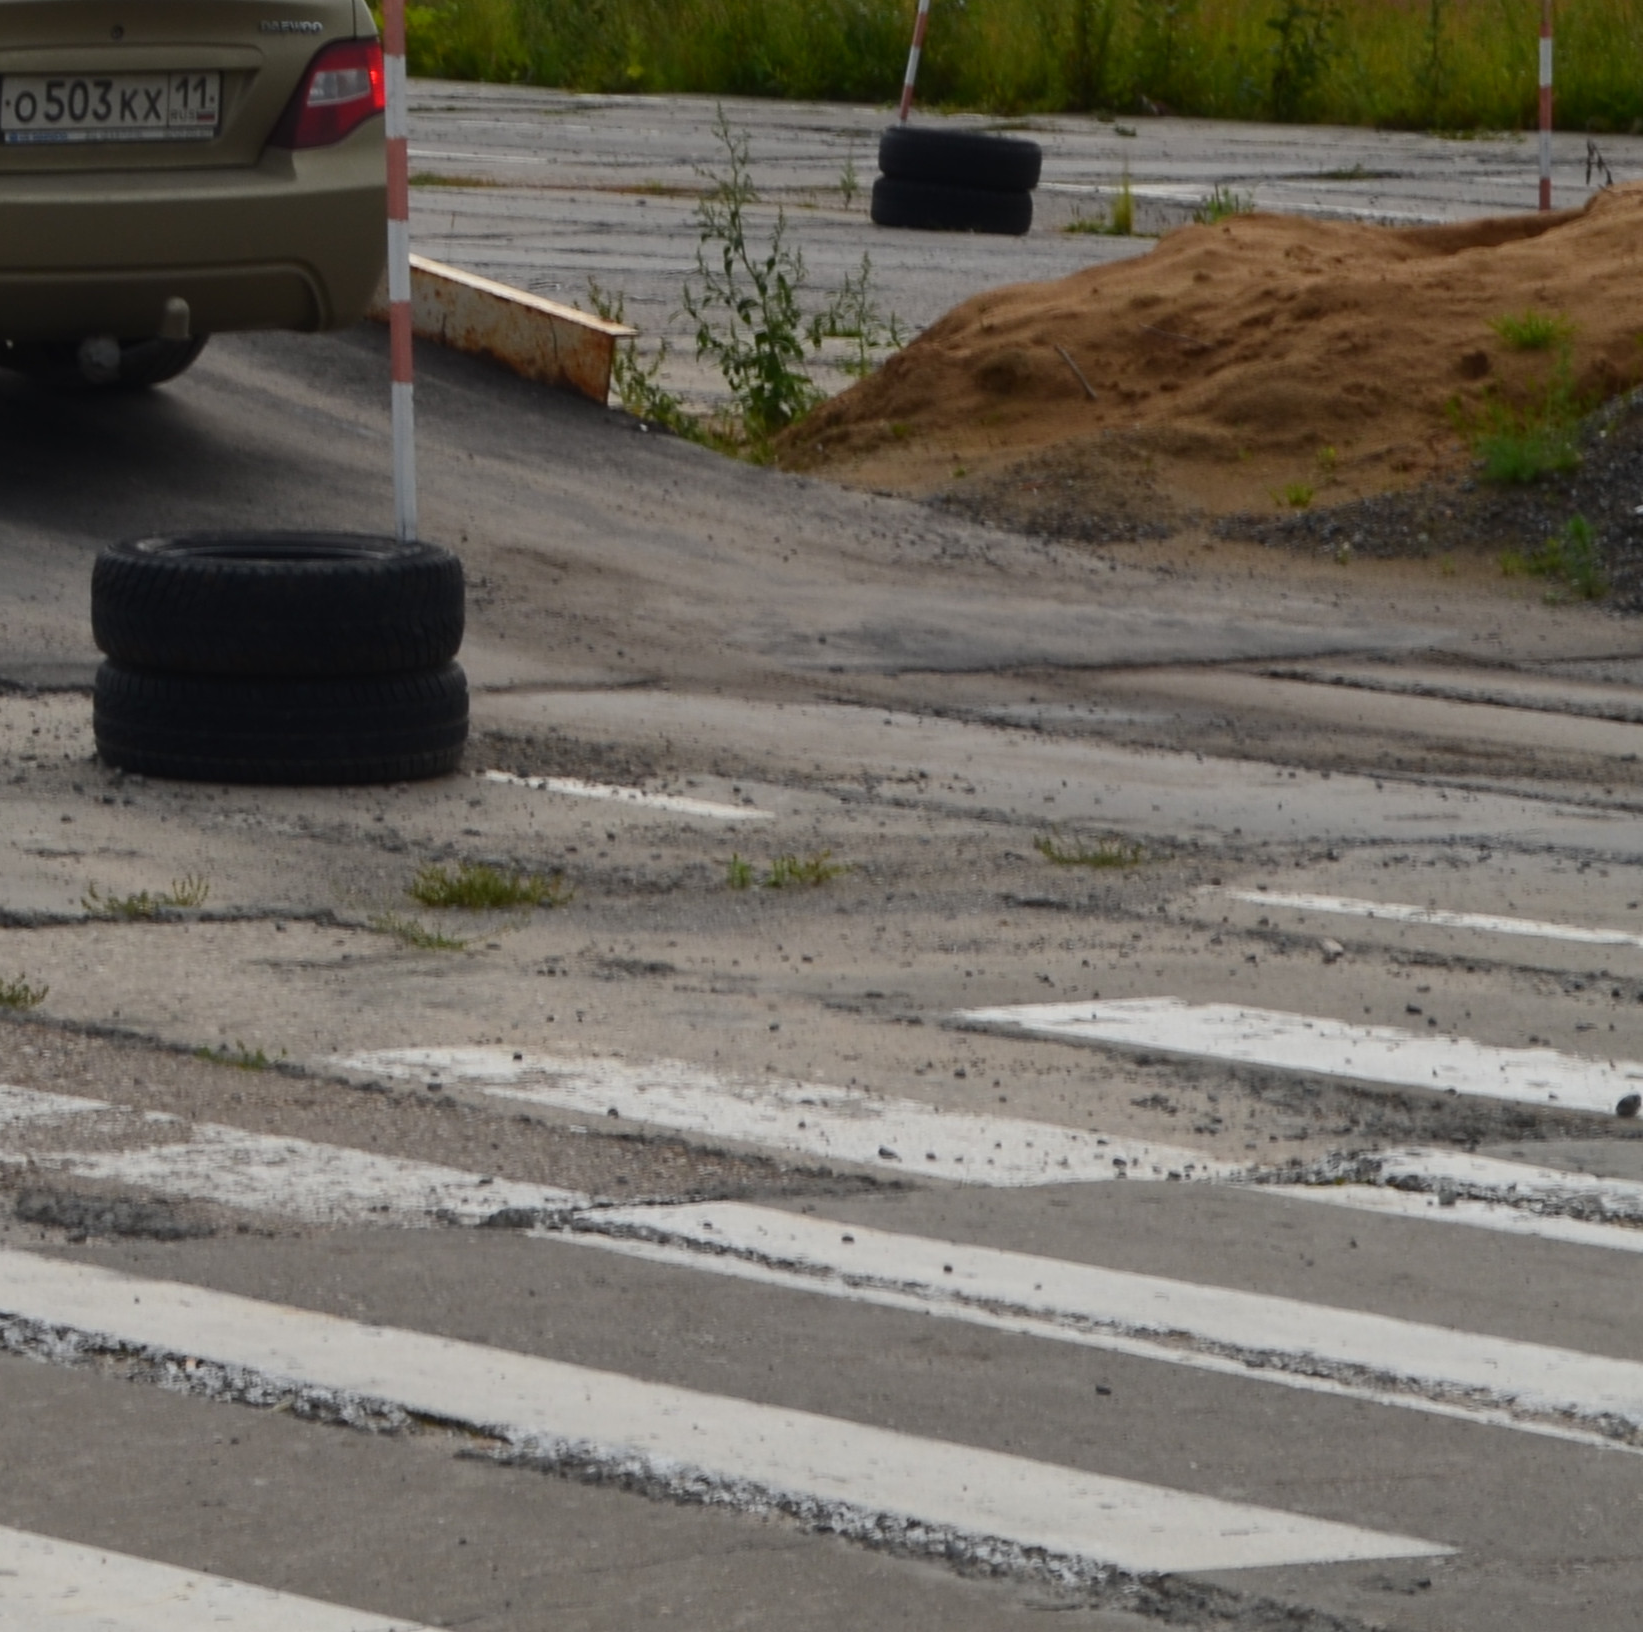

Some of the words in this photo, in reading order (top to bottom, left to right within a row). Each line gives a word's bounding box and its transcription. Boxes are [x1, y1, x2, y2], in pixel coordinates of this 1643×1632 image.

[259, 20, 324, 33] DAEWOO
[175, 76, 208, 109] 11
[170, 108, 196, 122] RUS
